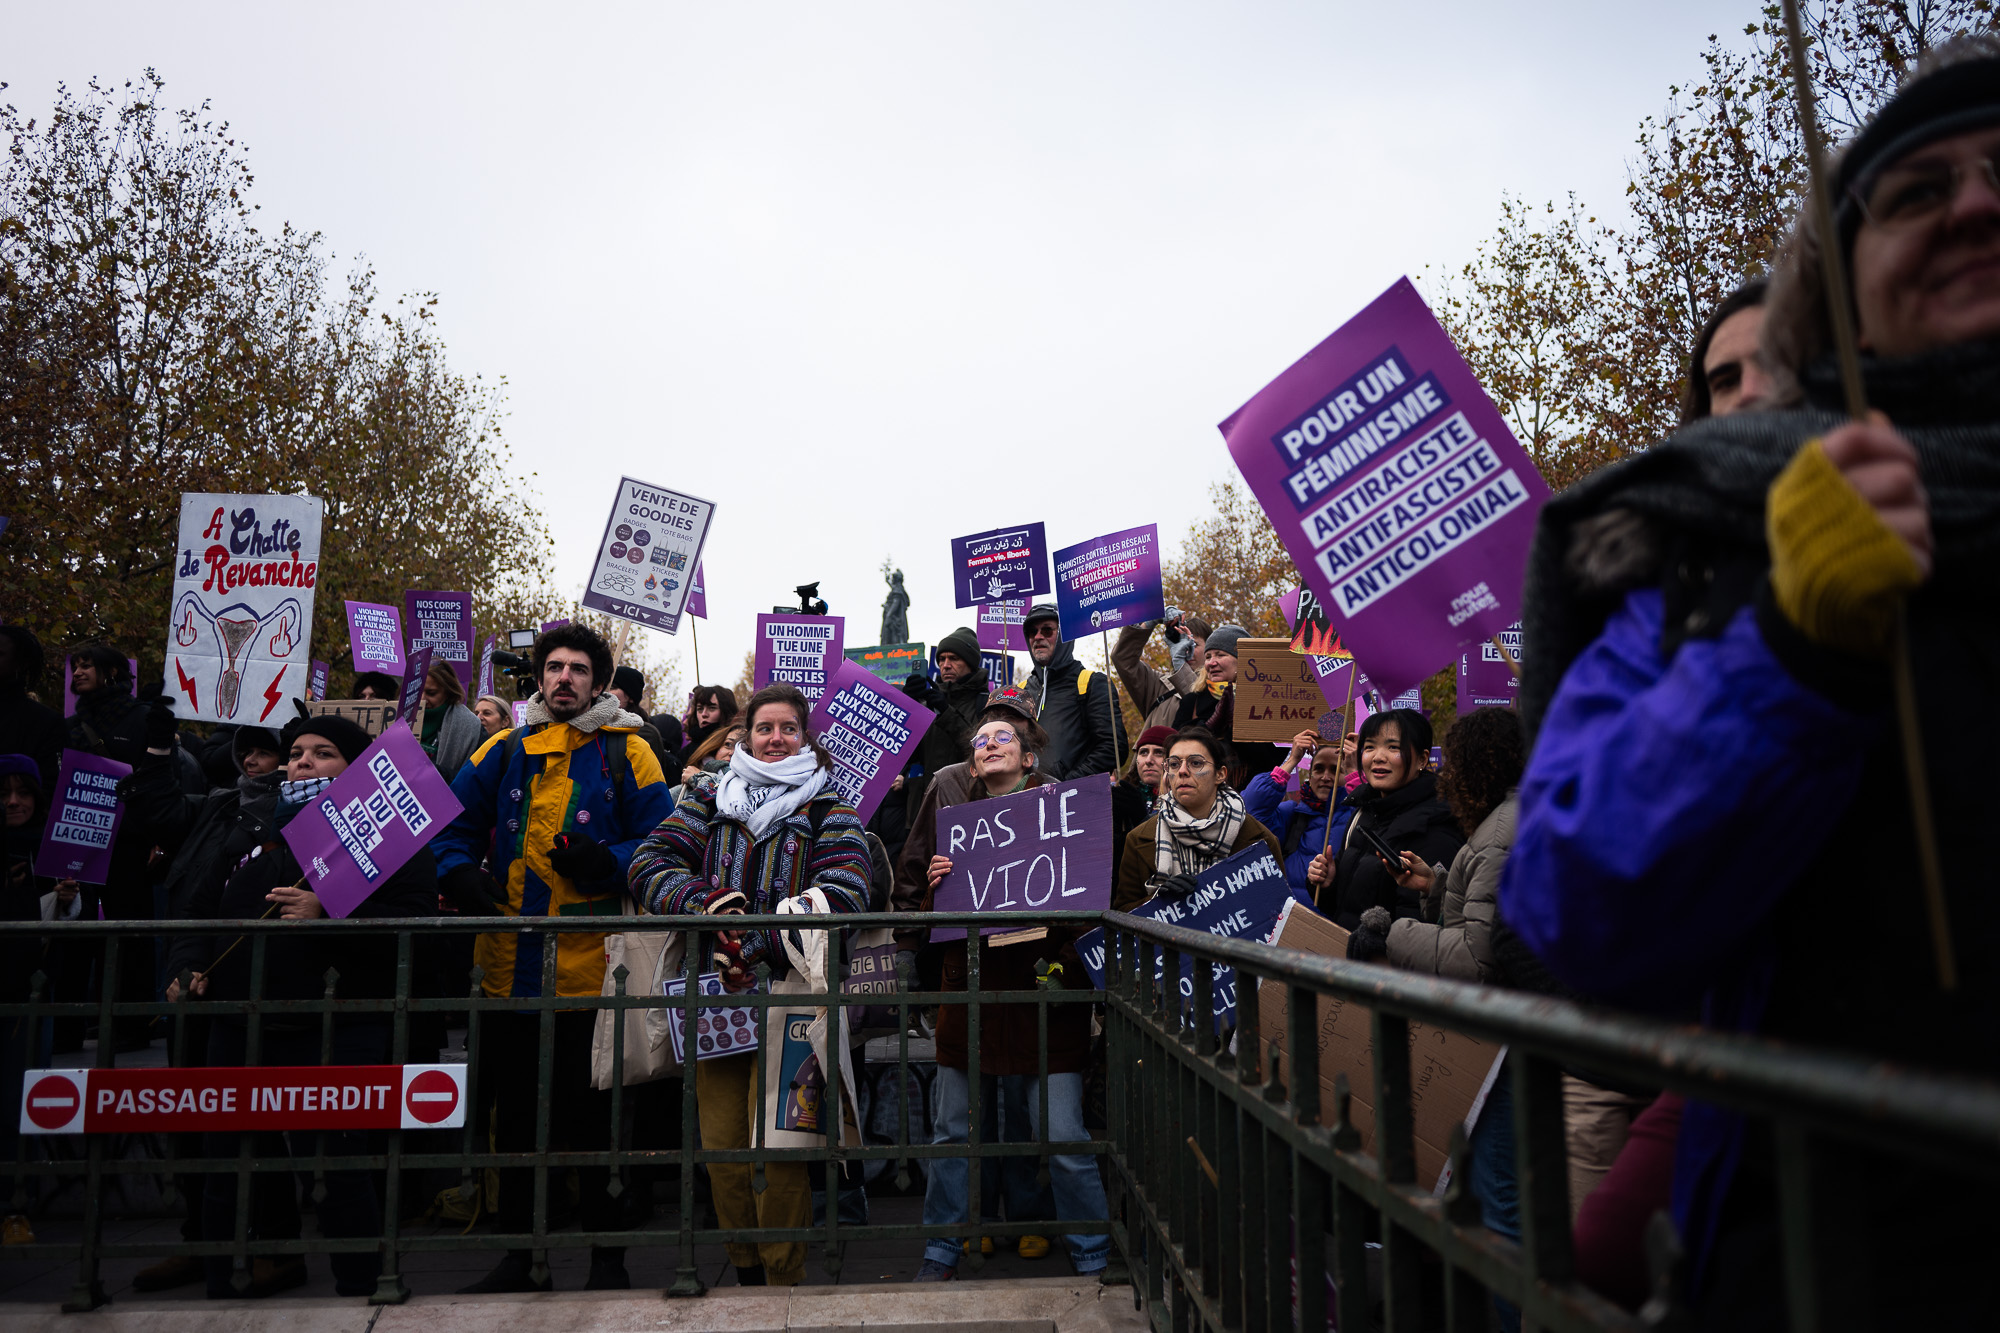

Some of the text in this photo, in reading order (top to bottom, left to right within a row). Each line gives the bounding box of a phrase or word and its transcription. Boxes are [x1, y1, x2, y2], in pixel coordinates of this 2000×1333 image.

[1281, 357, 1406, 461] POUR UN
[1288, 379, 1443, 503] FÉMINISME
[1313, 420, 1470, 541] ANTIRACISTE
[631, 487, 699, 516] VENTE DE
[1326, 447, 1496, 576] ANTIFASCISTE
[623, 518, 647, 529] BADGES
[629, 504, 694, 531] GOODIES
[202, 506, 302, 558] A Chatte
[660, 528, 693, 542] TOTE BAGS
[1057, 533, 1152, 573] FÉMINISTES CONTRE LES RÉSEAUX
[1342, 479, 1521, 609] ANTICOLONIAL
[993, 553, 1006, 561] vie,
[1060, 545, 1149, 583] DE TRAITE PROSTITUTIONNELLE,
[179, 544, 316, 595] de Revanche
[606, 562, 640, 575] BRACELETS
[652, 566, 679, 579] STICKERS
[1071, 559, 1138, 590] LE PROXÉNÉTISME
[1079, 583, 1135, 609] PORNO-CRIMINELLE
[1083, 587, 1090, 596] ET
[1451, 581, 1490, 611] nous
[357, 607, 388, 617] VIOLENCE
[416, 600, 461, 610] NOS CORPS
[417, 610, 461, 620] & LA TERRE
[623, 604, 640, 617] ICI
[354, 613, 368, 621] AUX
[364, 621, 379, 629] AUX
[378, 623, 397, 632] ADOS
[422, 620, 456, 629] NE SONT
[361, 635, 394, 646] COMPLICE
[364, 629, 390, 639] SILENCE
[424, 631, 456, 639] PAS DES
[769, 625, 830, 638] UN HOMME
[414, 640, 465, 650] TERRITOIRES
[776, 640, 823, 653] TUE UNE
[1484, 647, 1499, 659] LE
[362, 652, 398, 662] COUPABLE
[779, 655, 819, 668] FEMME
[772, 670, 825, 684] TOUS LES
[1244, 658, 1282, 682] Sous
[1262, 683, 1317, 700] Paillettes
[853, 682, 907, 724] VIOLENCE
[1248, 705, 1316, 720] LA RAGE
[834, 690, 860, 712] AUX
[858, 704, 910, 742] ENFANTS
[826, 701, 846, 718] ET
[842, 711, 871, 735] AUX
[866, 727, 903, 755] ADOS
[830, 725, 880, 761] SILENCE
[818, 734, 876, 777] COMPLICE
[73, 771, 119, 791] QUI SÈME
[66, 787, 118, 808] LA MISÈRE
[373, 754, 428, 832] CULTURE
[64, 807, 111, 827] RÉCOLTE
[368, 793, 392, 823] DU
[348, 803, 376, 849] VIOL
[949, 788, 1085, 855] RAS LE
[55, 825, 109, 845] LA COLÈRE
[321, 799, 380, 879] CONSENTEMENT
[311, 856, 326, 878] toutes
[316, 857, 331, 875] nous
[967, 846, 1087, 911] VIOL
[1185, 880, 1226, 917] SANS
[1225, 854, 1284, 894] HOMME,
[852, 956, 874, 974] JE
[96, 1085, 392, 1115] PASSAGE INTERDIT
